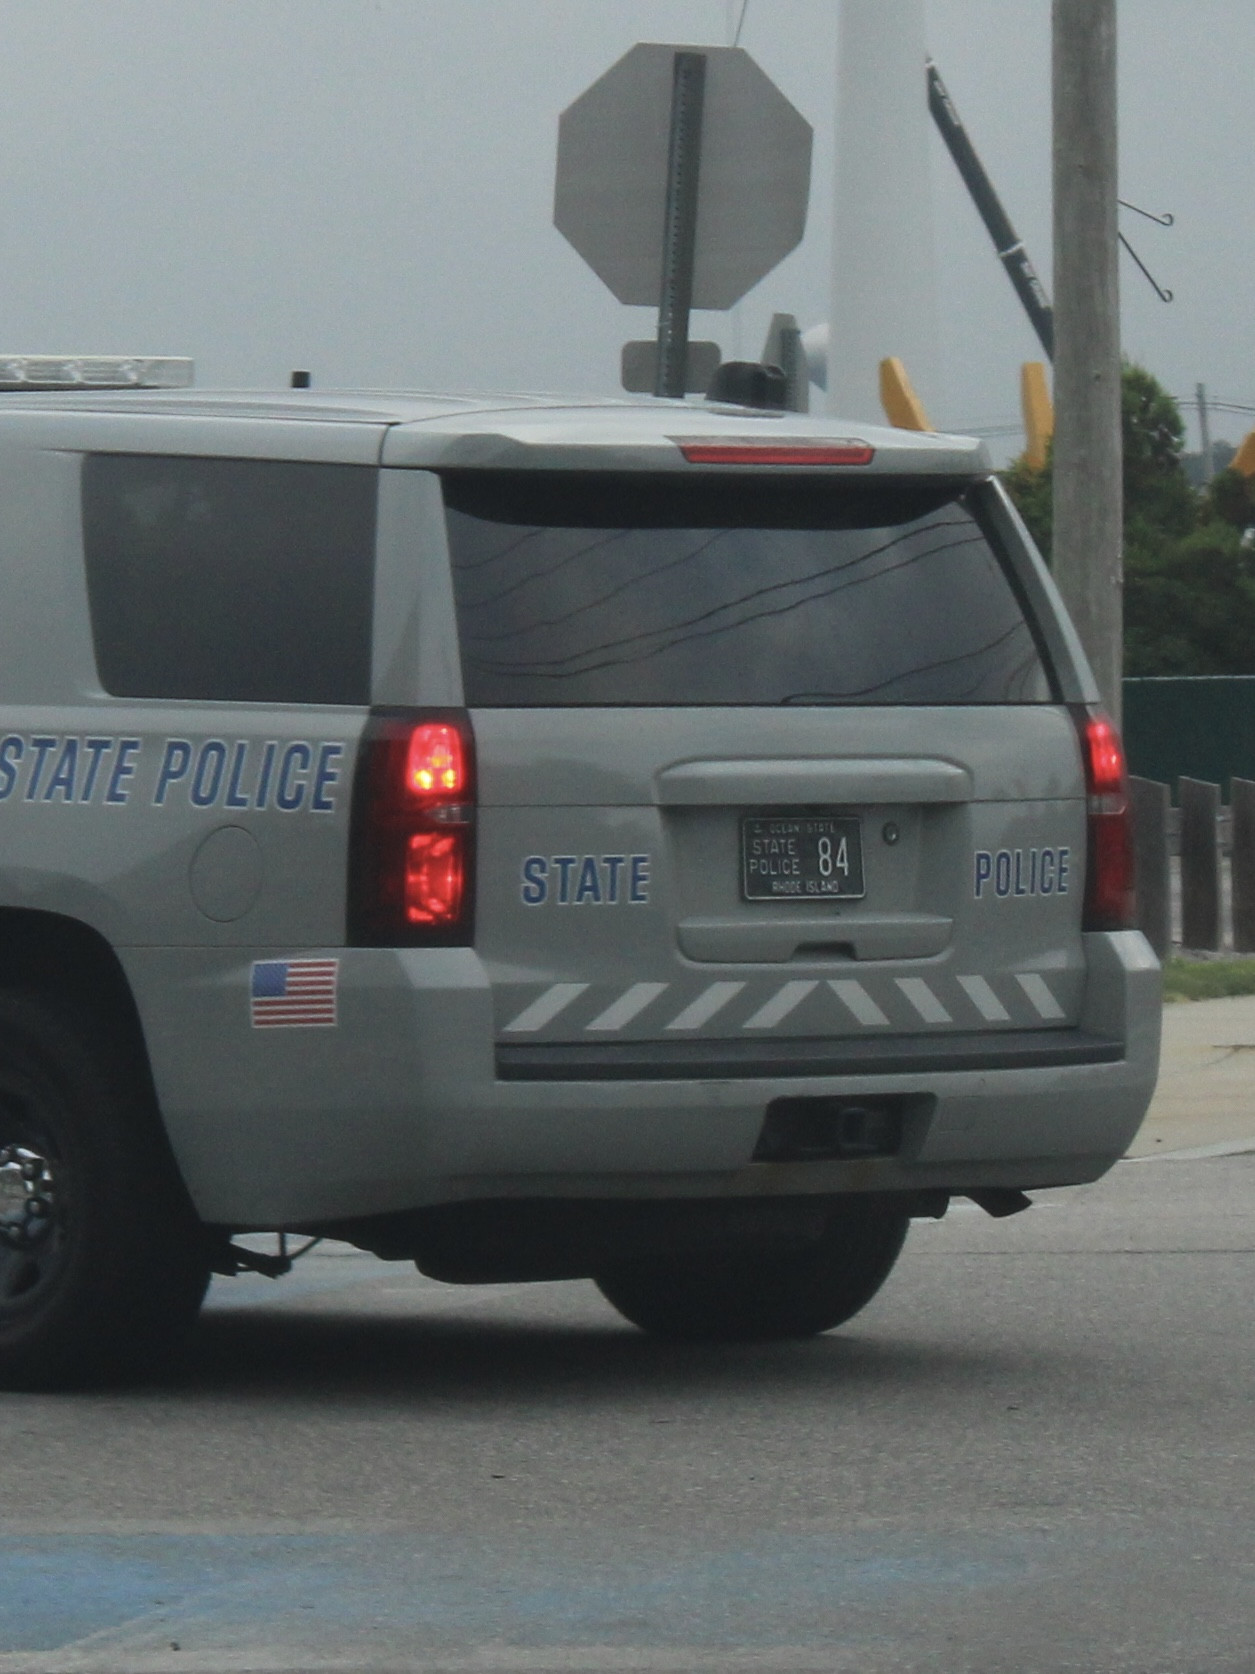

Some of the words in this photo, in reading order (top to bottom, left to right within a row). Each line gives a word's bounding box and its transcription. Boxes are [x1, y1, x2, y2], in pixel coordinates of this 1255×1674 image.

[152, 737, 345, 814] POLICE
[807, 823, 835, 833] STATE
[752, 839, 796, 855] STATE
[817, 836, 849, 877] 84
[749, 859, 801, 875] POLICE
[521, 854, 650, 906] STATE
[974, 847, 1070, 899] POLICE
[772, 880, 802, 893] RHODE
[806, 879, 840, 893] ISLAND
